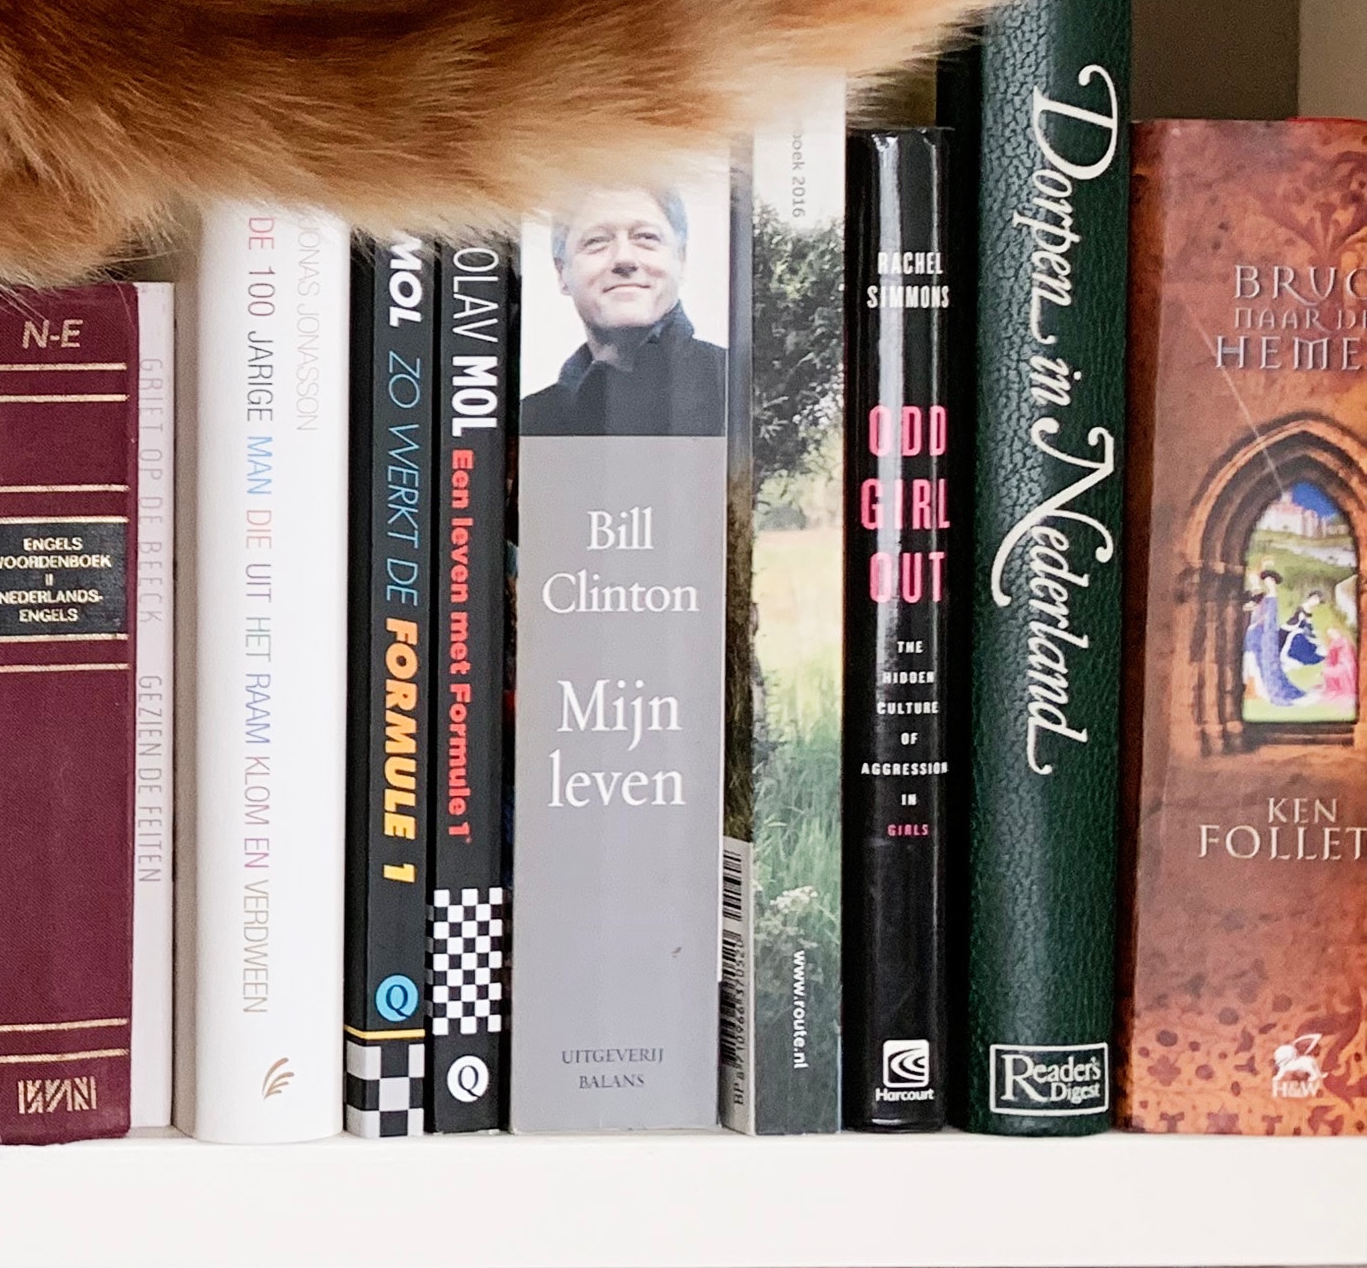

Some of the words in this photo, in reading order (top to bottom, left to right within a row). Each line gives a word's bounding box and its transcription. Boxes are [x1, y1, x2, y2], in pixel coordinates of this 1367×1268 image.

[1012, 64, 1119, 345] Dorpen
[877, 251, 943, 276] RACHEL
[451, 246, 500, 345] OLAV
[867, 285, 951, 309] SIMMONS
[21, 319, 84, 350] N-E
[1030, 355, 1082, 407] in
[450, 356, 499, 439] MOL
[867, 405, 947, 457] ODD
[246, 436, 273, 496] MAN
[860, 478, 951, 530] GIRL
[586, 507, 654, 551] Bill
[23, 537, 83, 551] ENGELS
[869, 551, 947, 603] OUT
[542, 570, 700, 614] Clinton
[991, 417, 1115, 776] Nederland
[19, 609, 78, 622] ENGELS
[897, 640, 923, 654] THE
[882, 670, 935, 684] HIDDEN
[557, 678, 683, 752] Mijn
[876, 700, 939, 714] CULTURE
[383, 616, 418, 840] FORMULE
[901, 732, 918, 746] OF
[548, 749, 686, 809] leven
[861, 760, 949, 776] AGGRESSION
[901, 793, 917, 806] IN
[1267, 798, 1338, 825] KEN
[887, 823, 929, 836] GIRLS
[383, 863, 416, 883] 1
[792, 950, 808, 1070] www.route.nl
[560, 1048, 664, 1065] UITGEVERIJ
[578, 1074, 645, 1089] BALANS
[875, 1087, 935, 1102] Harcourt
[1049, 1080, 1102, 1103] Digest
